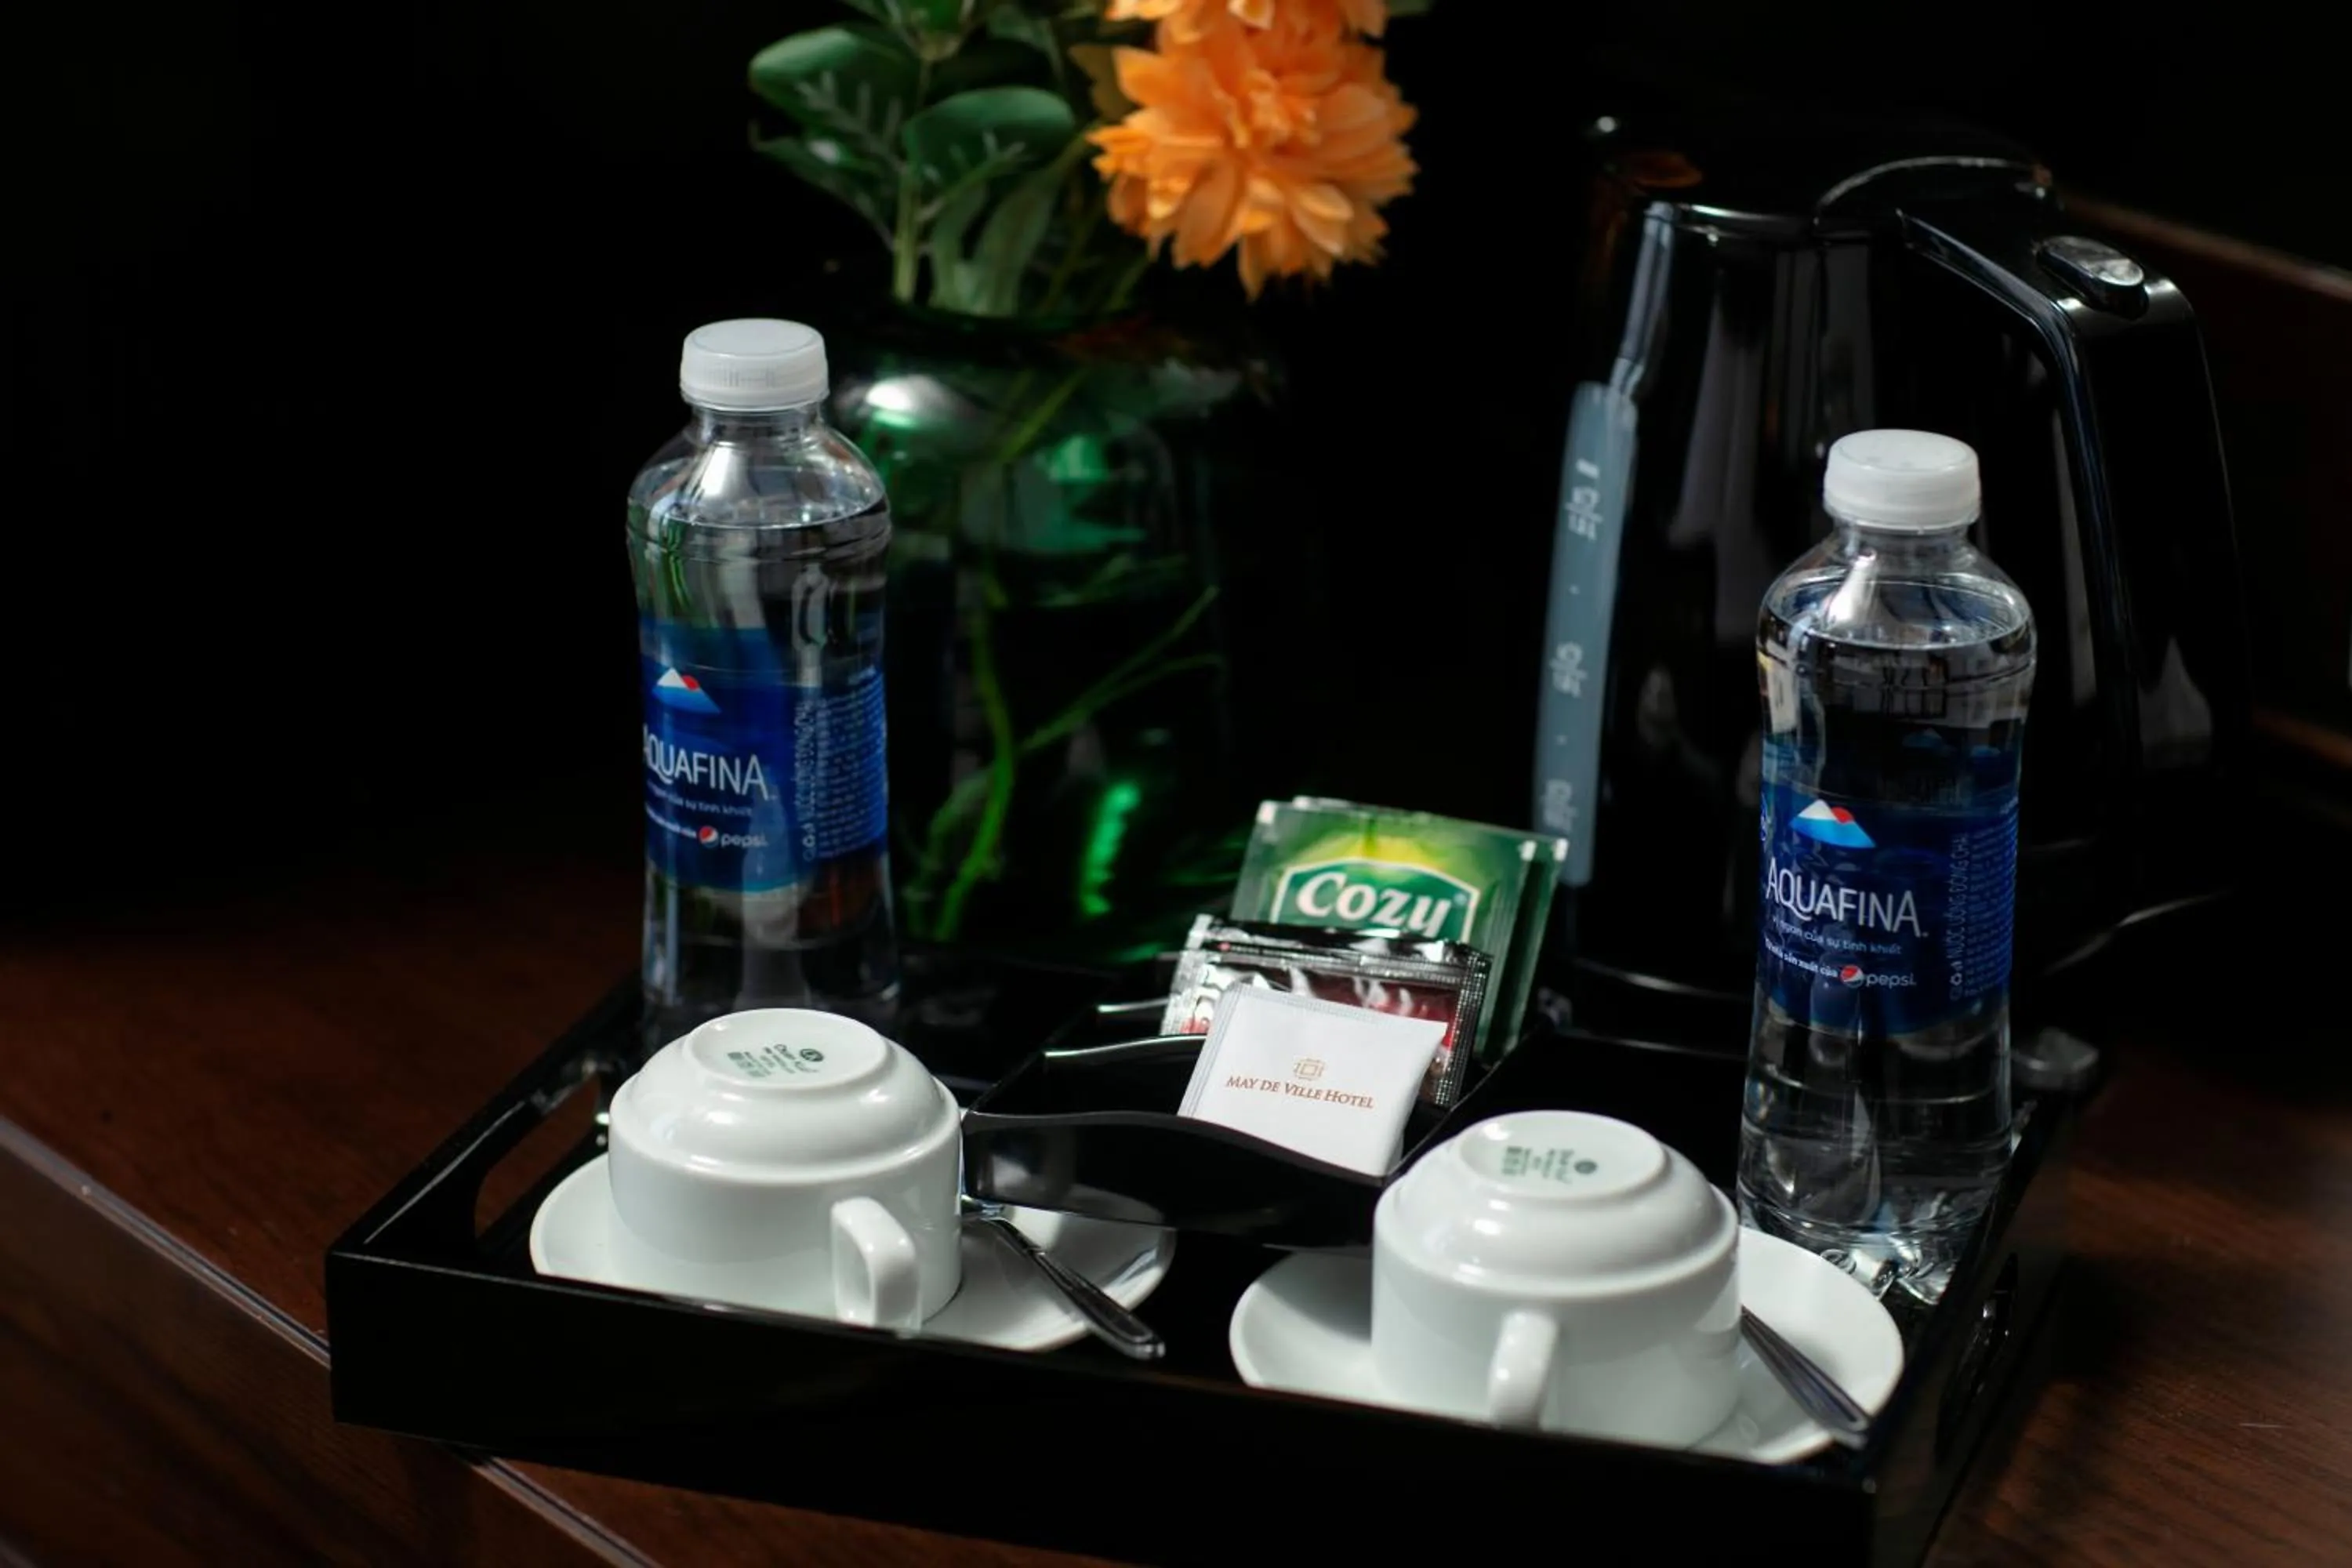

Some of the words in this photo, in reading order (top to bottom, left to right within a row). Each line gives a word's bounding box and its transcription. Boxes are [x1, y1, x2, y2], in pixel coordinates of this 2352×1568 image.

[1298, 872, 1452, 938] Cozy
[1766, 857, 1920, 938] AQUAFINA
[1865, 972, 1914, 989] pepsi
[1225, 1075, 1258, 1089] MAY
[1260, 1080, 1281, 1092] DE
[1284, 1083, 1323, 1100] VILLE
[1325, 1091, 1374, 1109] HOTEL
